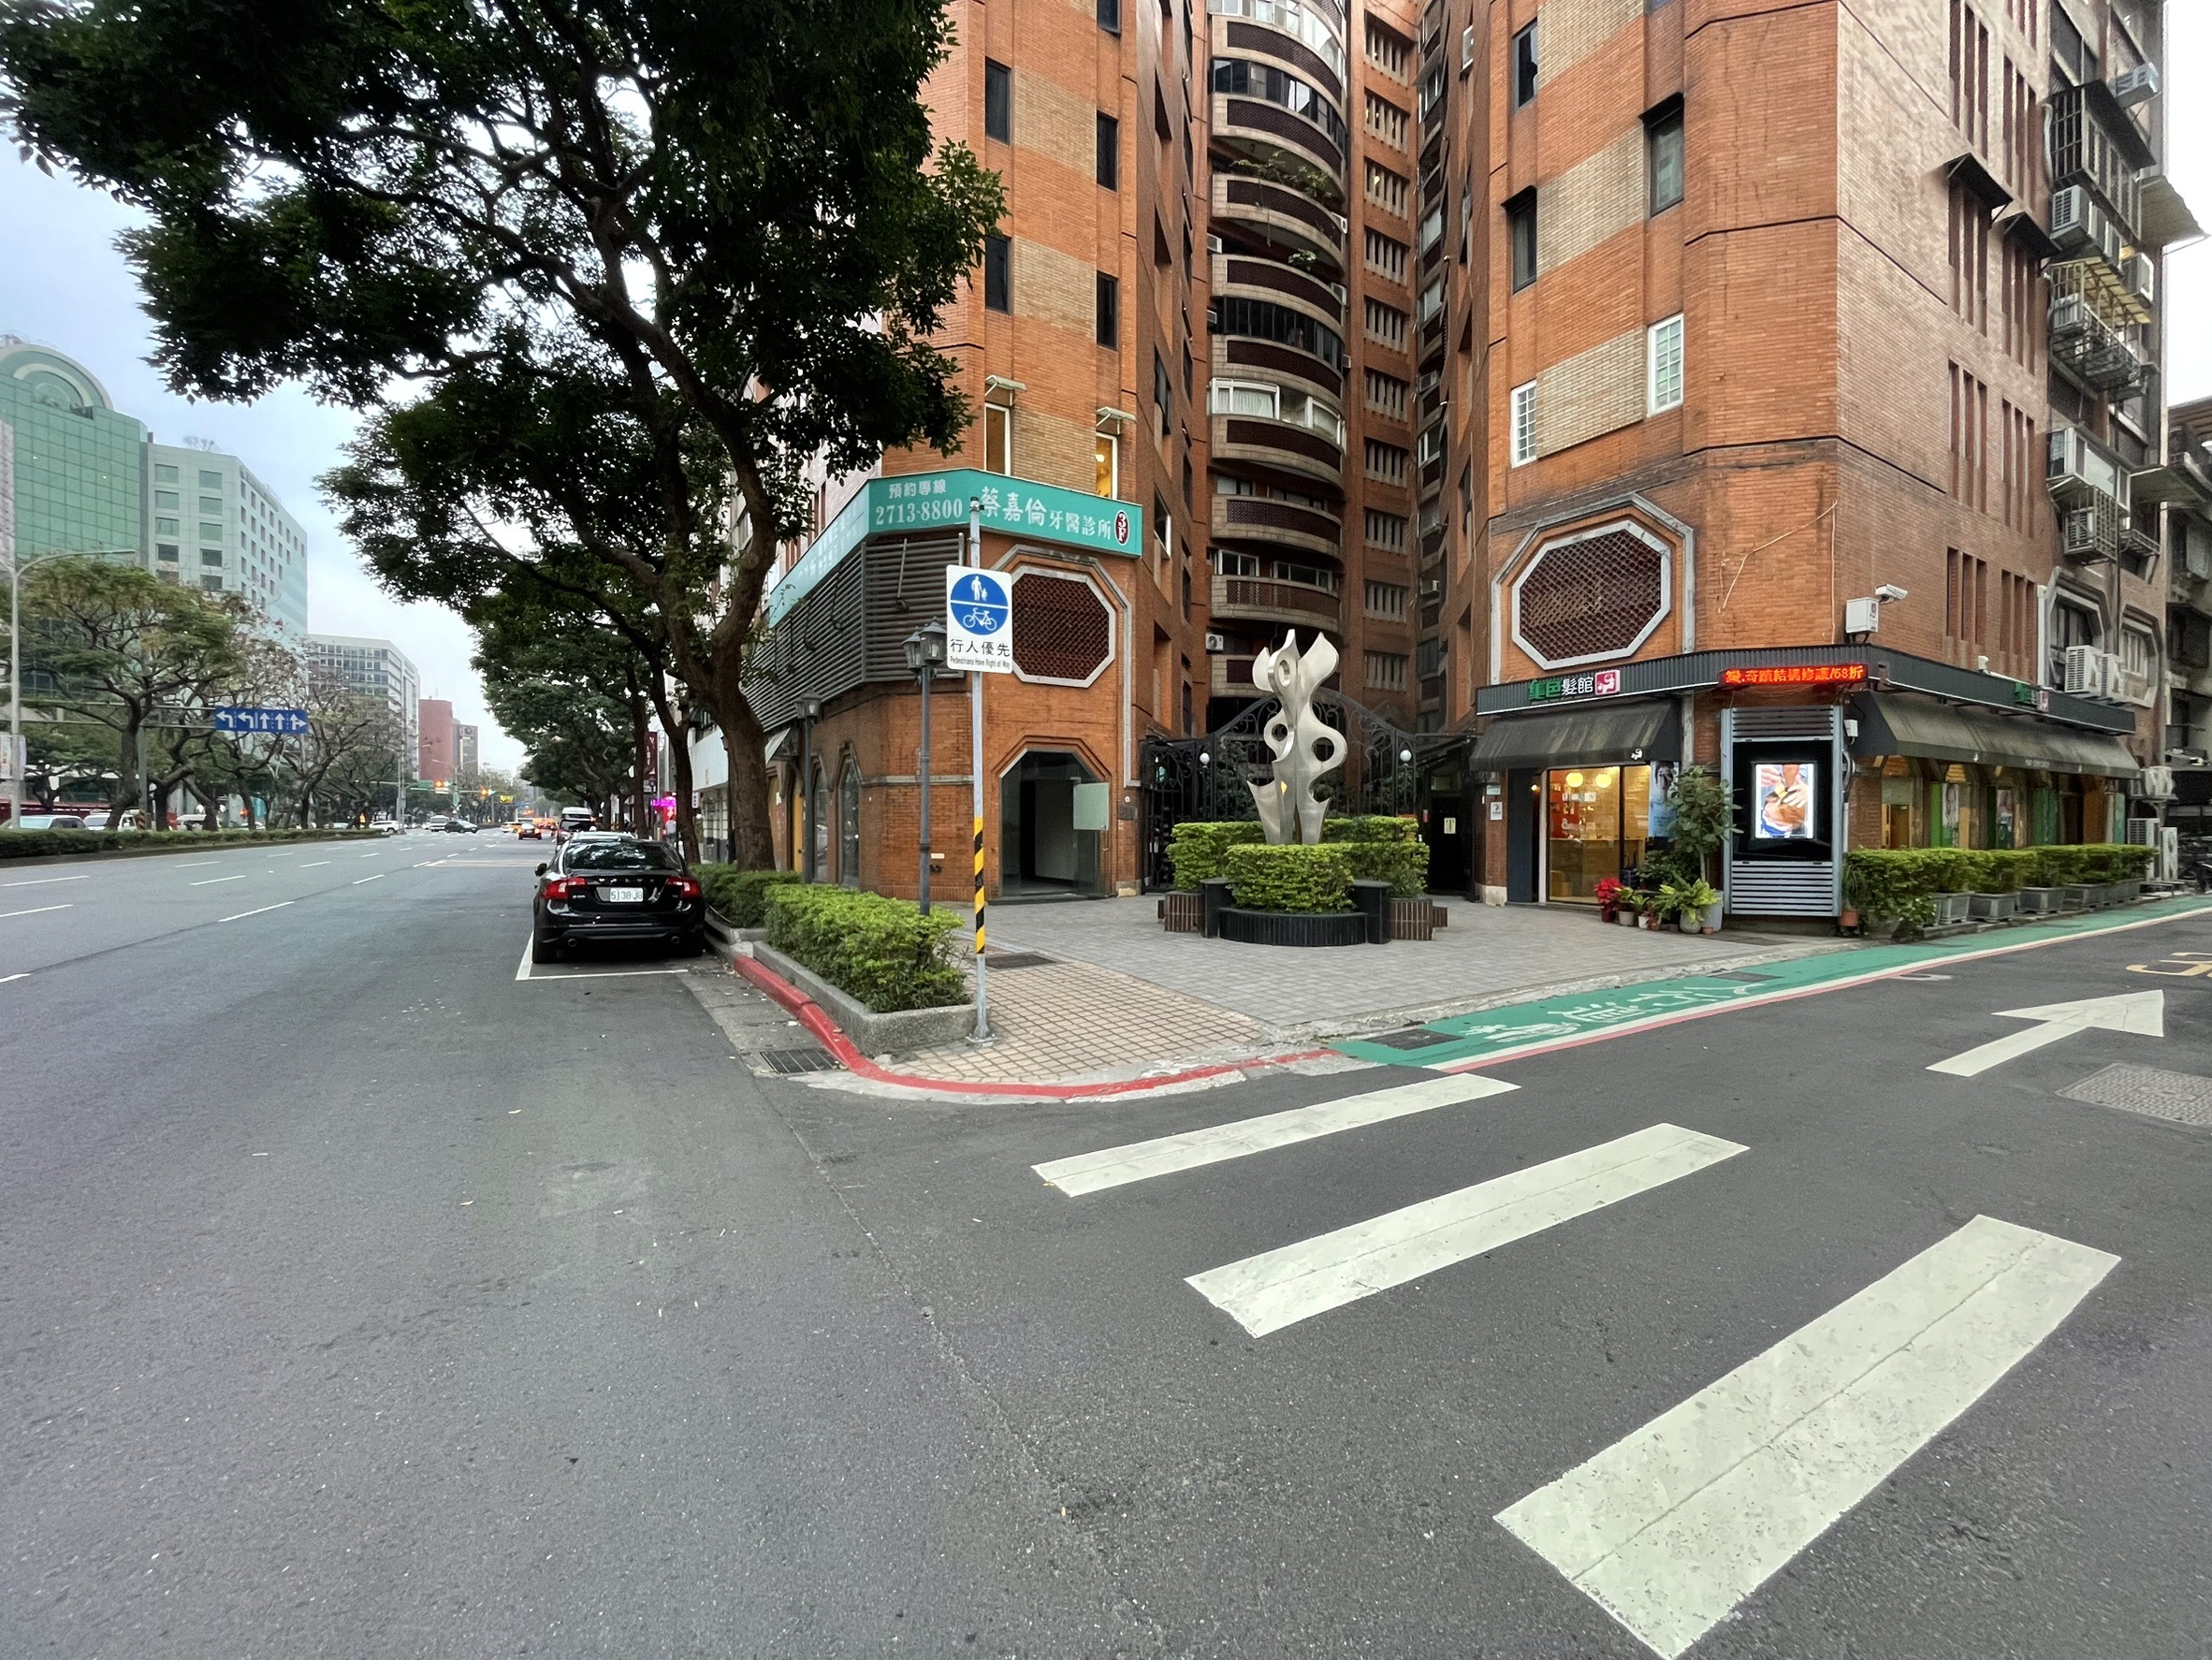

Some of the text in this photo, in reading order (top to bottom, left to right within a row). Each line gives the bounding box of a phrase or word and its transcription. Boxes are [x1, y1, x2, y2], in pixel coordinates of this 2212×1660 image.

[889, 479, 947, 499] 預約專線
[876, 498, 963, 525] 2713-8800
[981, 486, 1112, 540] 蔡嘉倫牙醫診所
[1118, 513, 1127, 541] 3F
[950, 638, 1011, 657] 行人優先
